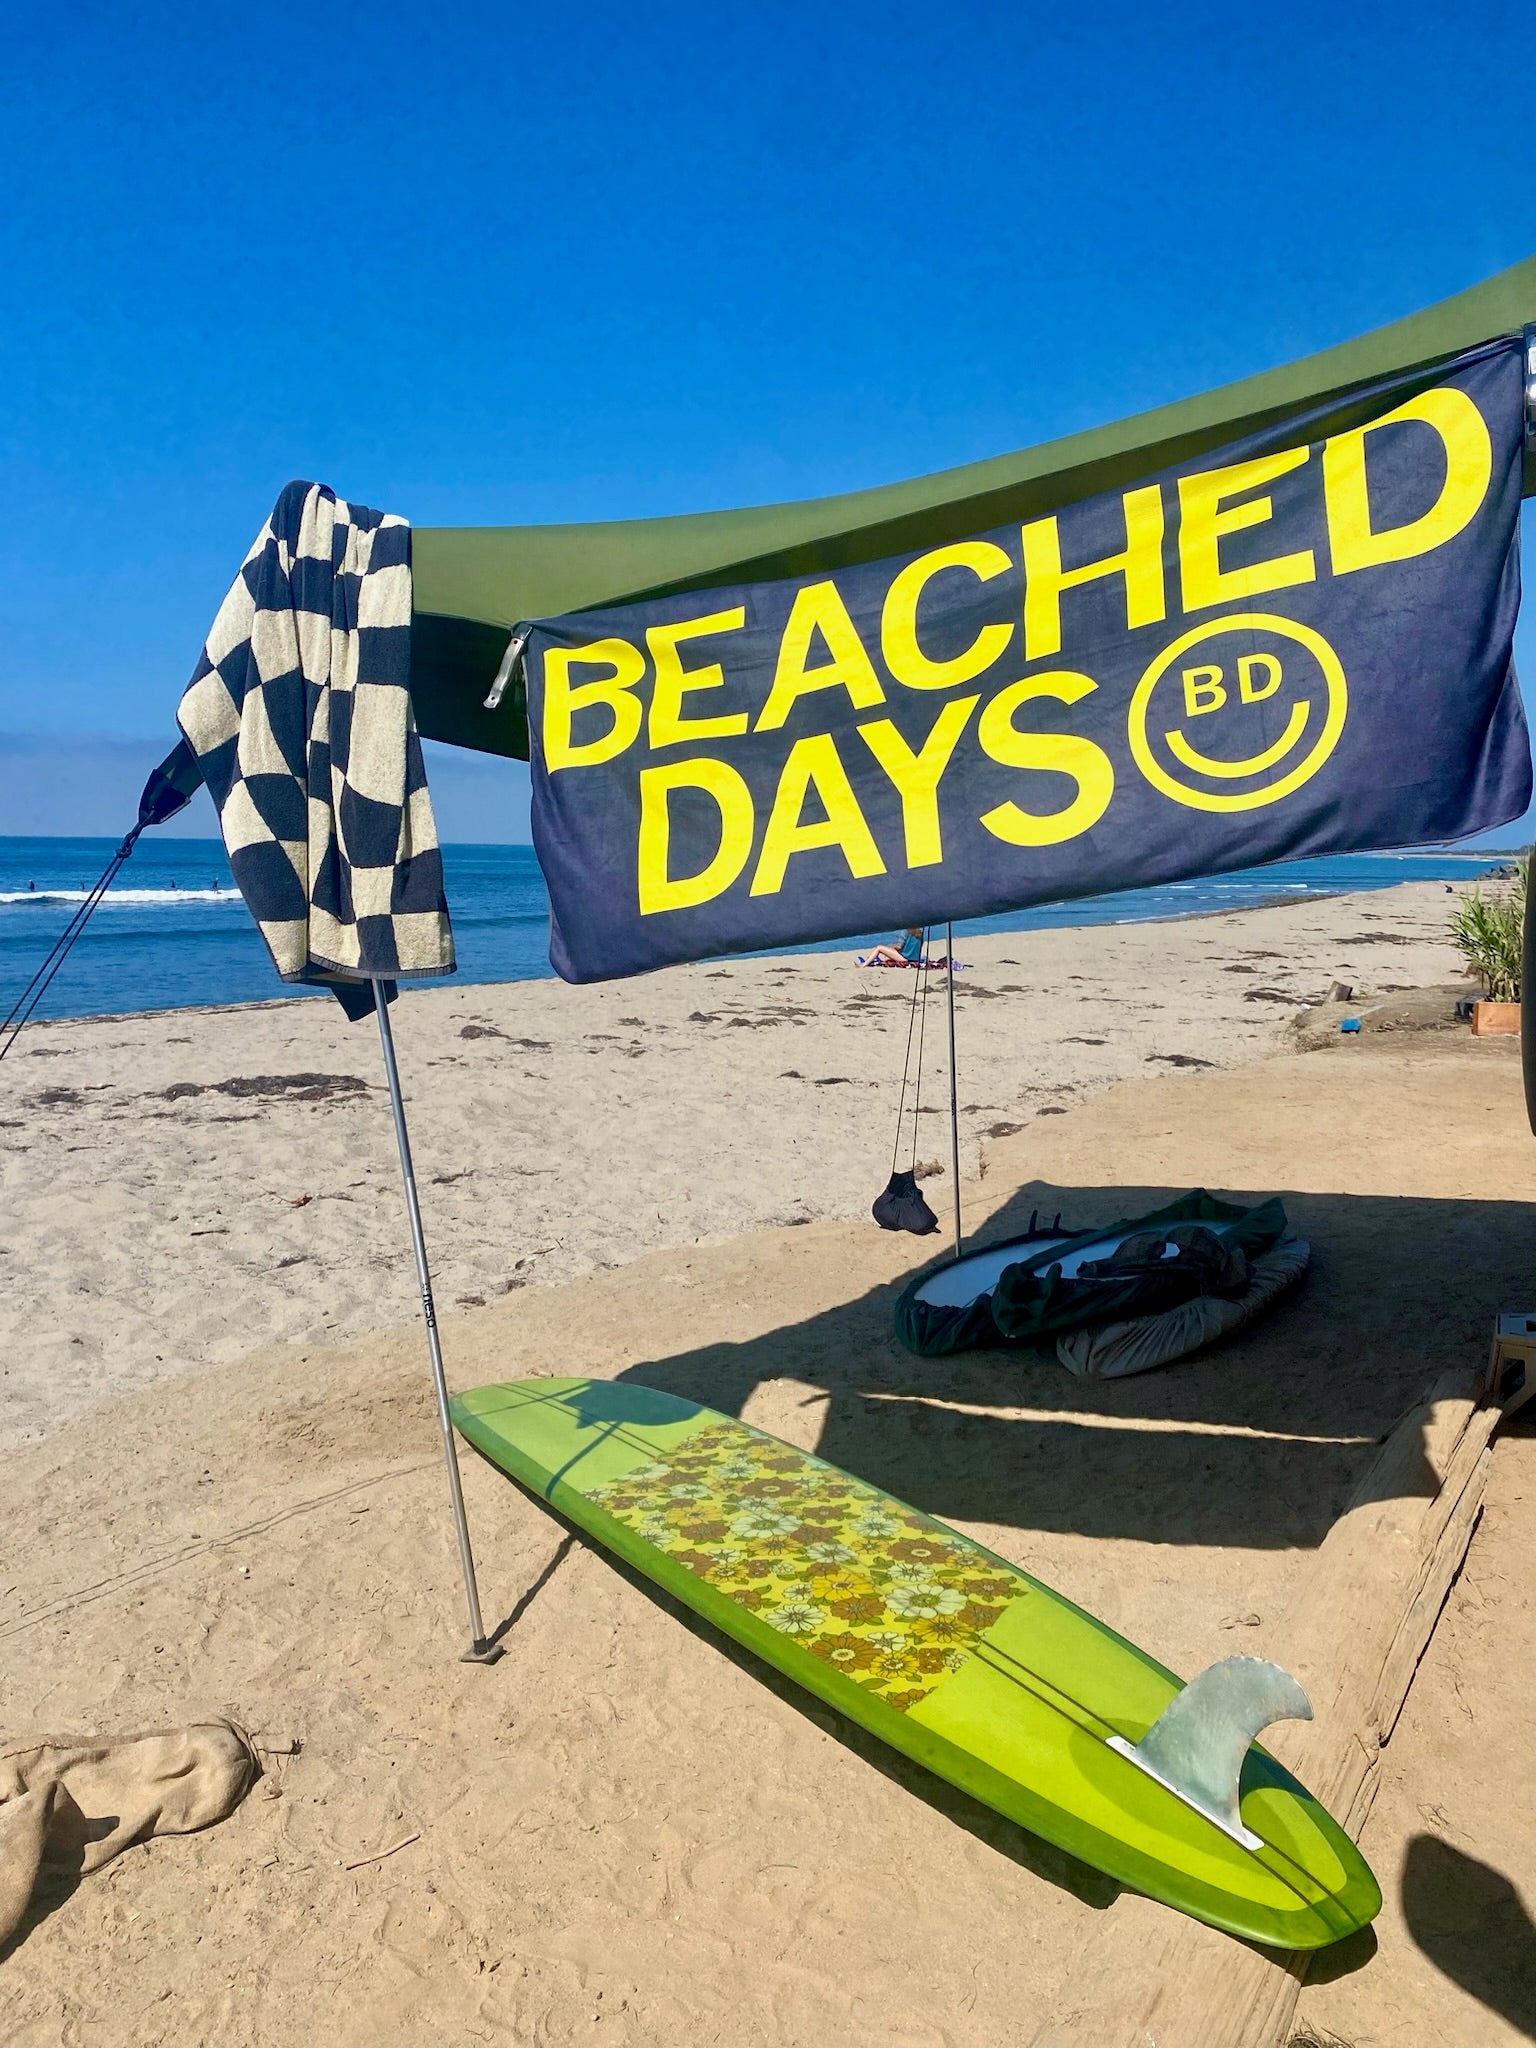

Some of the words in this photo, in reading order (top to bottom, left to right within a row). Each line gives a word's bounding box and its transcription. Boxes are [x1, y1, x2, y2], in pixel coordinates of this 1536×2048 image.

[543, 388, 1491, 771] BEACHED
[1183, 654, 1281, 716] BD
[638, 671, 1114, 914] DAYS
